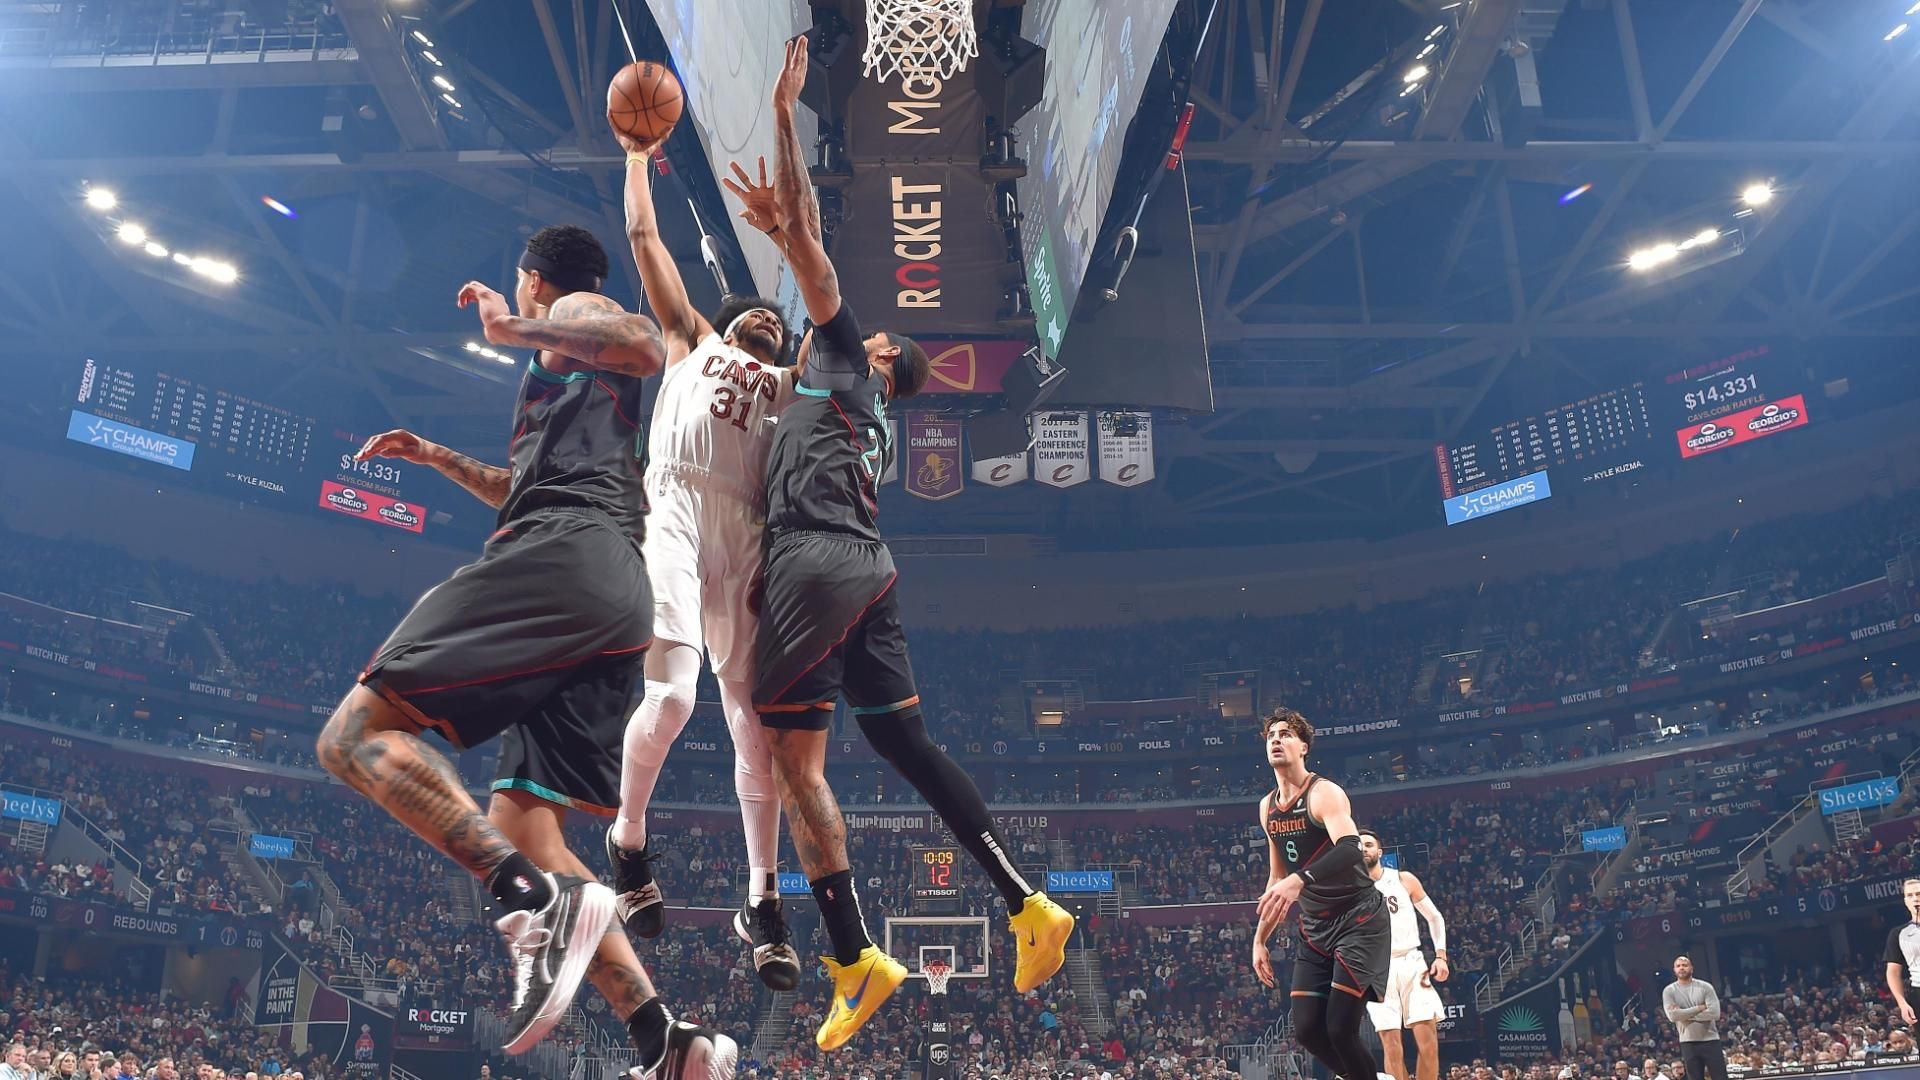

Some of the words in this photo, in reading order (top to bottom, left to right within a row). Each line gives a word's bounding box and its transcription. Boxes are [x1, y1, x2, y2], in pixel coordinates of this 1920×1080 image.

[891, 176, 942, 308] ROCKET
[1033, 246, 1052, 311] Sprite
[78, 359, 94, 403] WIZARDS
[701, 356, 778, 401] CAVS
[1684, 374, 1757, 410] $14,331
[710, 387, 752, 433] 31
[1733, 394, 1765, 410] RAFFLE
[1749, 410, 1798, 430] GEORGIO'S
[925, 428, 943, 438] NBA
[1043, 430, 1078, 438] EASTERN
[1687, 428, 1734, 448] GEORGIO'S
[112, 442, 135, 453] Group
[113, 430, 178, 457] CHAMPS
[911, 437, 957, 448] CHAMPIONS
[1036, 441, 1086, 449] CONFERENCE
[1039, 451, 1084, 459] CHAMPIONS
[341, 454, 401, 483] $14,331
[1594, 468, 1614, 480] KYLE
[237, 473, 257, 485] KYLE
[375, 484, 401, 497] RAFFLE
[1480, 481, 1536, 506] CHAMPS
[327, 494, 367, 510] GEORGIO'S
[379, 508, 418, 524] GEORGIO'S
[1850, 624, 1879, 641] WATCH
[1879, 620, 1897, 634] THE
[26, 645, 53, 660] WATCH
[54, 652, 69, 664] THE
[84, 660, 96, 671] ON
[1720, 660, 1749, 673] WATCH
[1749, 656, 1765, 668] THE
[1781, 649, 1793, 659] ON
[189, 682, 216, 695] WATCH
[216, 687, 231, 698] THE
[246, 692, 258, 702] ON
[1561, 694, 1587, 704] WATCH
[1586, 689, 1601, 700] THE
[1616, 684, 1628, 694] ON
[1439, 713, 1465, 723] WATCH
[1465, 709, 1480, 719] THE
[1495, 706, 1506, 715] ON
[1314, 728, 1332, 736] ET
[1334, 725, 1353, 735] EM
[1355, 719, 1400, 733] KNOW.
[684, 742, 716, 751] FOULS
[844, 743, 851, 753] 6
[1038, 742, 1046, 753] 5
[1078, 743, 1101, 752] FG%
[1104, 742, 1123, 752] 100
[1139, 740, 1171, 750] FOULS
[1203, 737, 1224, 746] TOL
[1490, 782, 1511, 791] M103
[1822, 781, 1895, 808] Sheely's
[845, 813, 924, 833] Huntington
[1269, 817, 1306, 835] District
[924, 852, 953, 864] 10:09
[1286, 840, 1299, 862] 8
[1687, 846, 1721, 857] Homes
[931, 864, 950, 886] 12
[1050, 874, 1109, 889] Sheely's
[1662, 873, 1689, 883] Homes
[1864, 879, 1904, 900] WATCH
[1662, 920, 1671, 933] 6
[1690, 918, 1701, 927] 10
[1767, 906, 1779, 916] 12
[1798, 898, 1807, 912] 5
[29, 905, 47, 918] 100
[84, 909, 95, 925] 0
[113, 914, 177, 935] REBOUNDS
[199, 926, 206, 941] 1
[245, 937, 263, 949] 100
[268, 987, 278, 1000] IN
[278, 986, 295, 999] THE
[266, 1000, 293, 1014] PAINT
[409, 1008, 468, 1025] ROCKET
[420, 1022, 455, 1034] Mortgage
[1498, 1033, 1548, 1041] CASAMIGOS
[932, 1049, 948, 1060] ups
